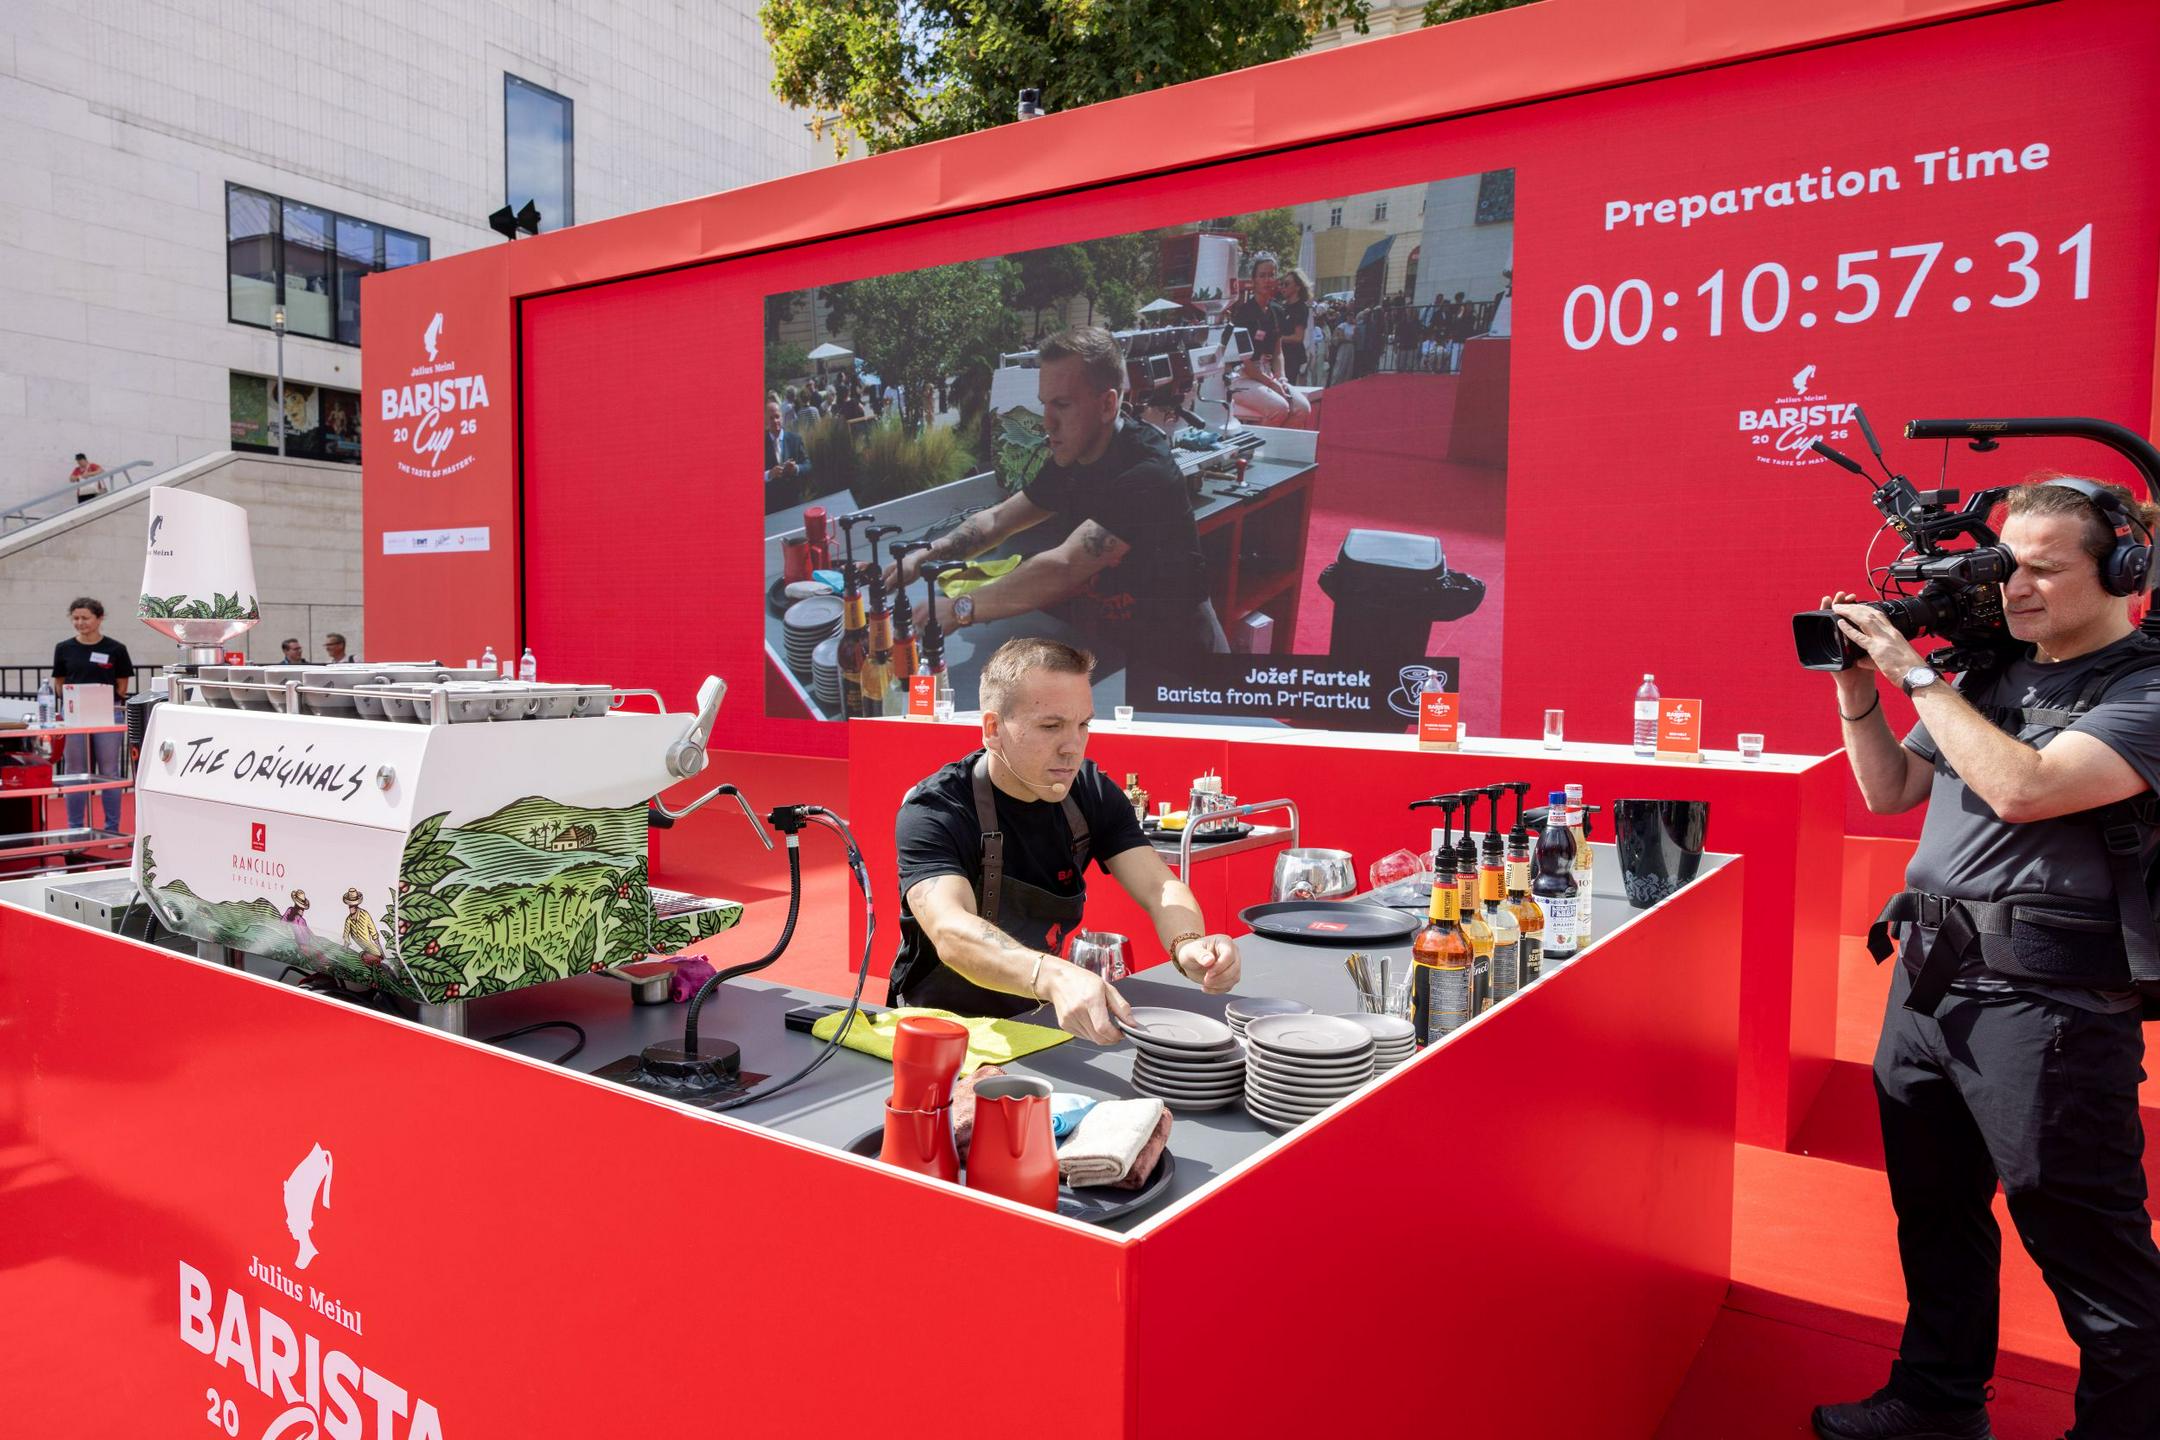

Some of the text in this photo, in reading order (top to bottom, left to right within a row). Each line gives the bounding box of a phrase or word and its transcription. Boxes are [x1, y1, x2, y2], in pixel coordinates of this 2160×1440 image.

[1603, 142, 2051, 231] Preparation Time
[1562, 223, 2094, 351] 00:10:57:31
[411, 361, 456, 377] Julius Meinl
[382, 375, 490, 420] BARISTA
[1739, 403, 1859, 431] BARISTA
[393, 408, 477, 467] 20 Cup 26
[1752, 423, 1848, 460] 20 Cup 26
[398, 462, 410, 474] THE
[411, 468, 431, 478] TASTE
[432, 469, 442, 478] OF
[1757, 456, 1771, 464] THE
[1157, 686, 1223, 704] Barista
[1227, 689, 1272, 706] from
[1245, 668, 1371, 688] Jožef Fartek
[180, 737, 230, 777] THE
[232, 854, 286, 878] RANCILIO
[248, 1256, 363, 1337] Julius Meinl
[206, 1388, 240, 1438] 20
